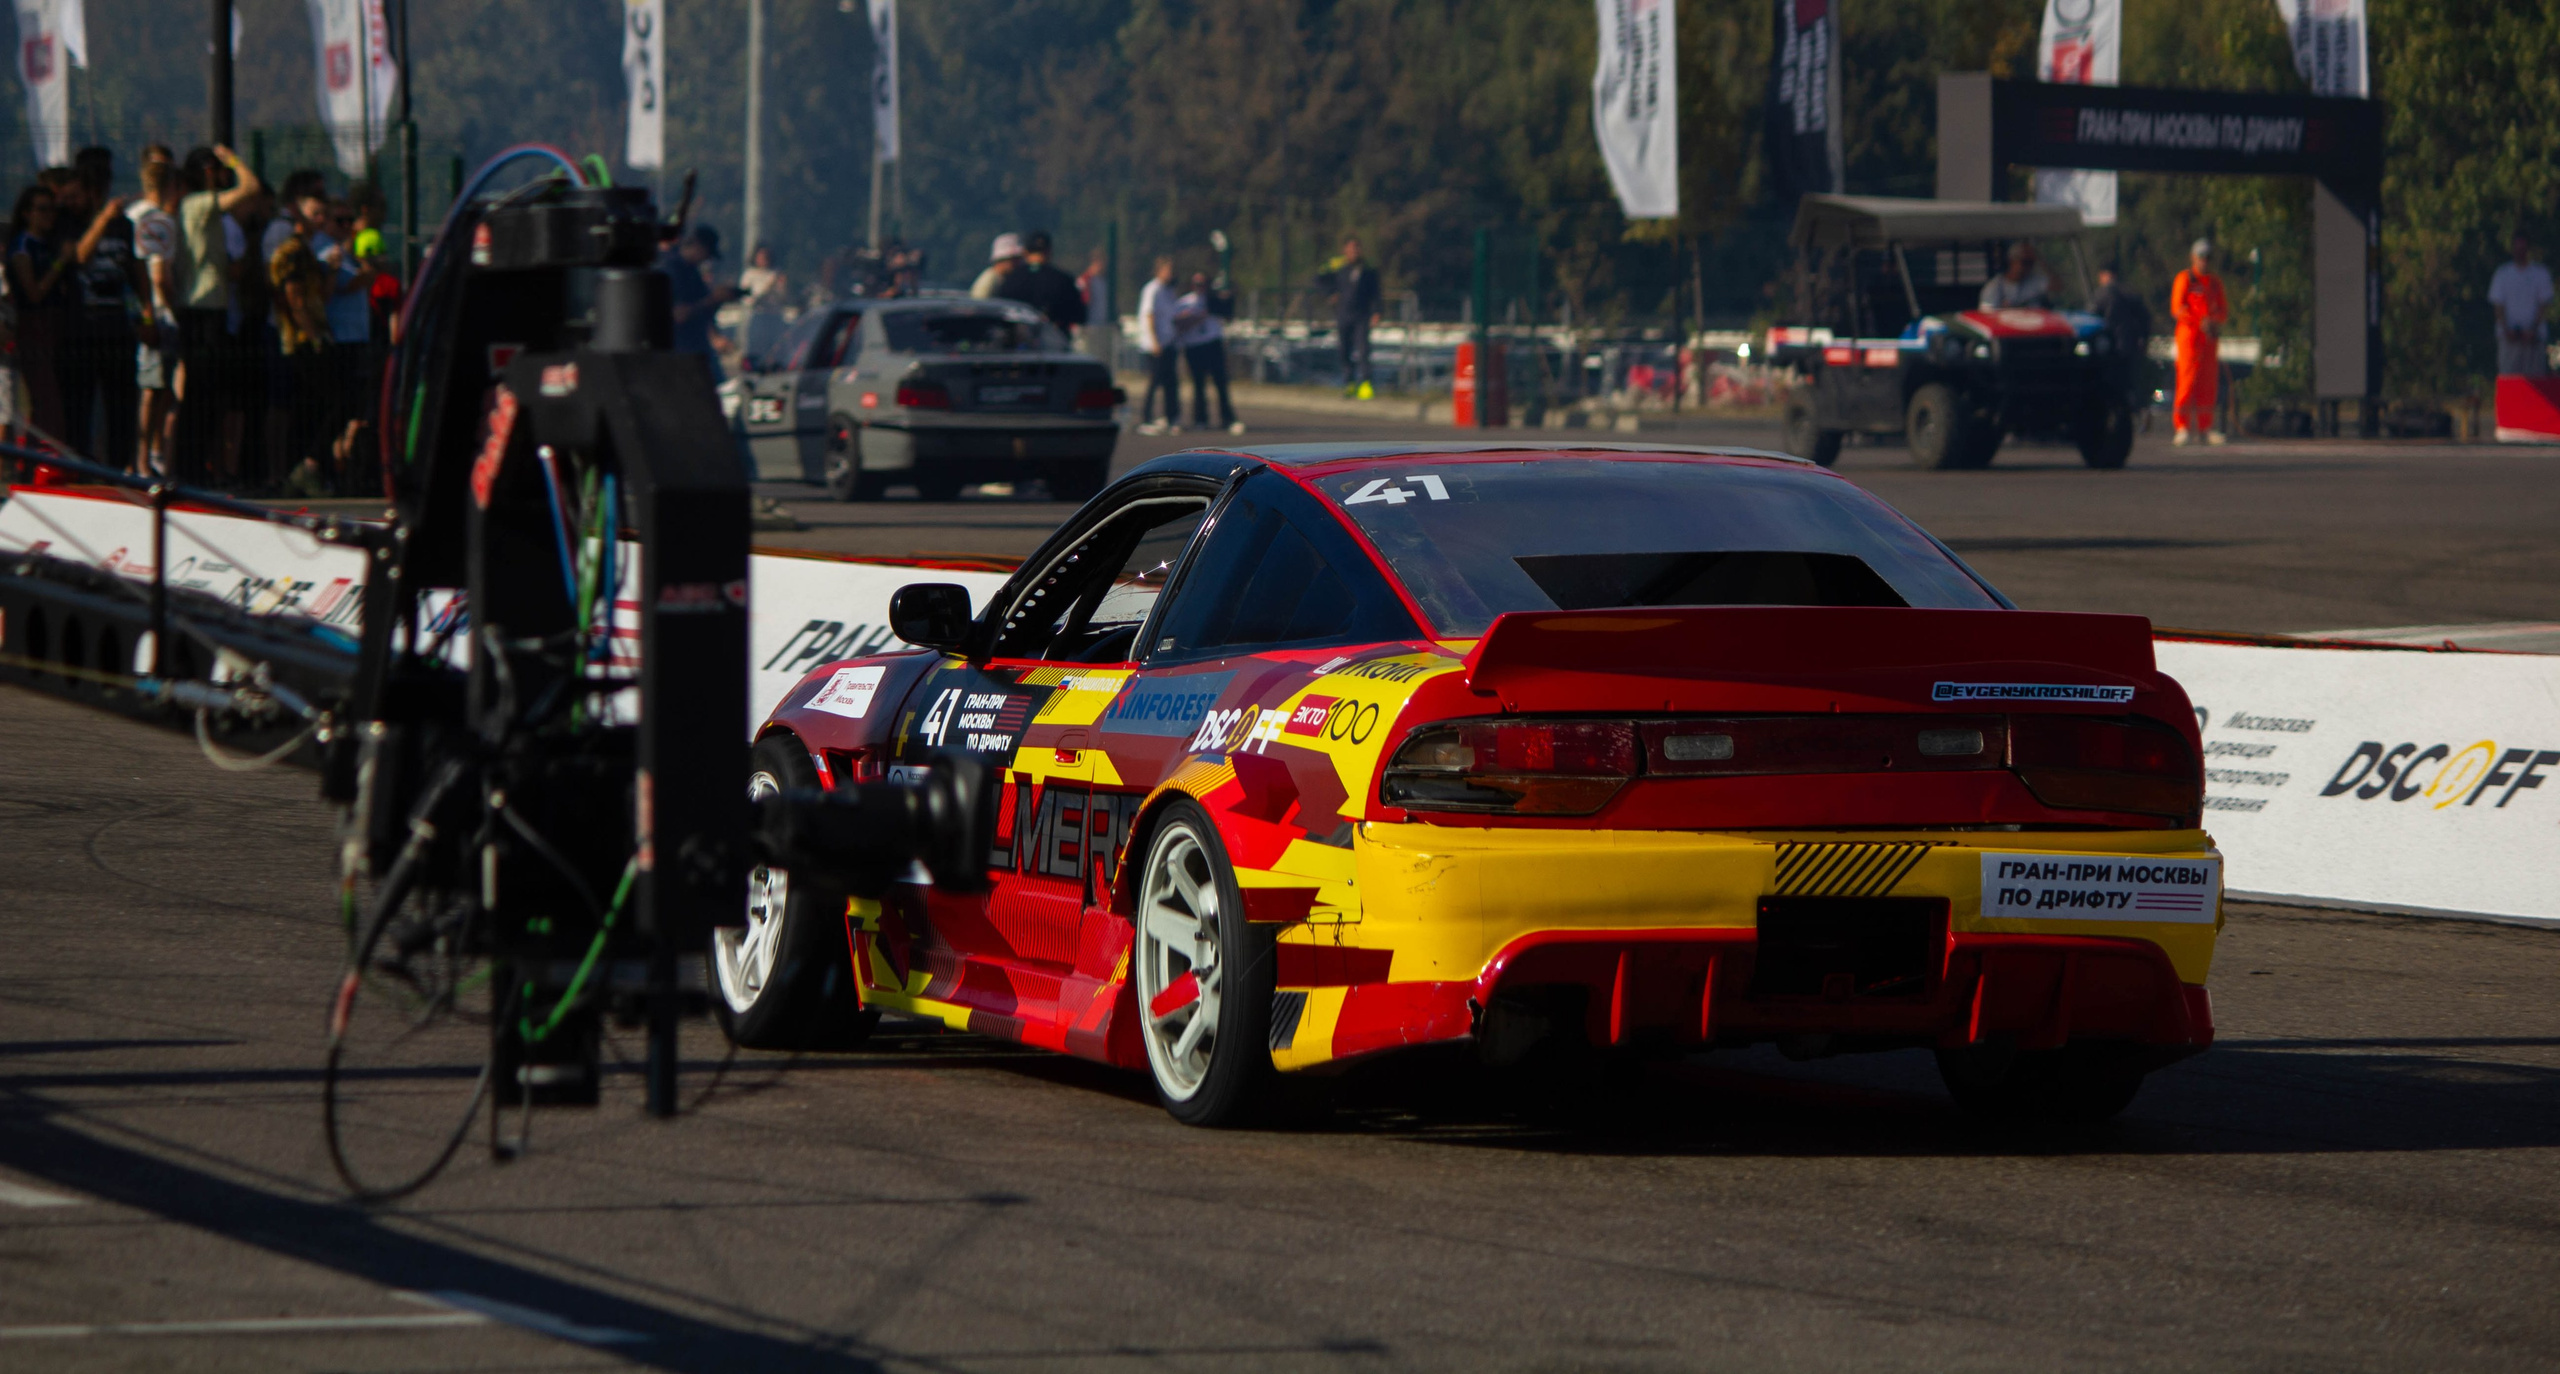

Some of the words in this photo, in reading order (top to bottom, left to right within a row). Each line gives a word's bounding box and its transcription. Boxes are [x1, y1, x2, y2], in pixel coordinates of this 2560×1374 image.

[1343, 474, 1451, 505] 41
[963, 694, 1008, 710] ГРАН-ПРИ
[919, 688, 963, 747] 41
[957, 713, 997, 730] МОСКВЫ
[1292, 705, 1327, 726] ЭКТО
[1319, 698, 1380, 746] 100
[965, 733, 980, 751] ПО
[977, 735, 1013, 753] ДРИФТУ
[1998, 861, 2112, 882] ГРАН-ПРИ
[2117, 865, 2209, 885] МОСКВЫ
[1997, 888, 2032, 906] ПО
[2035, 889, 2133, 910] ДРИФТУ
